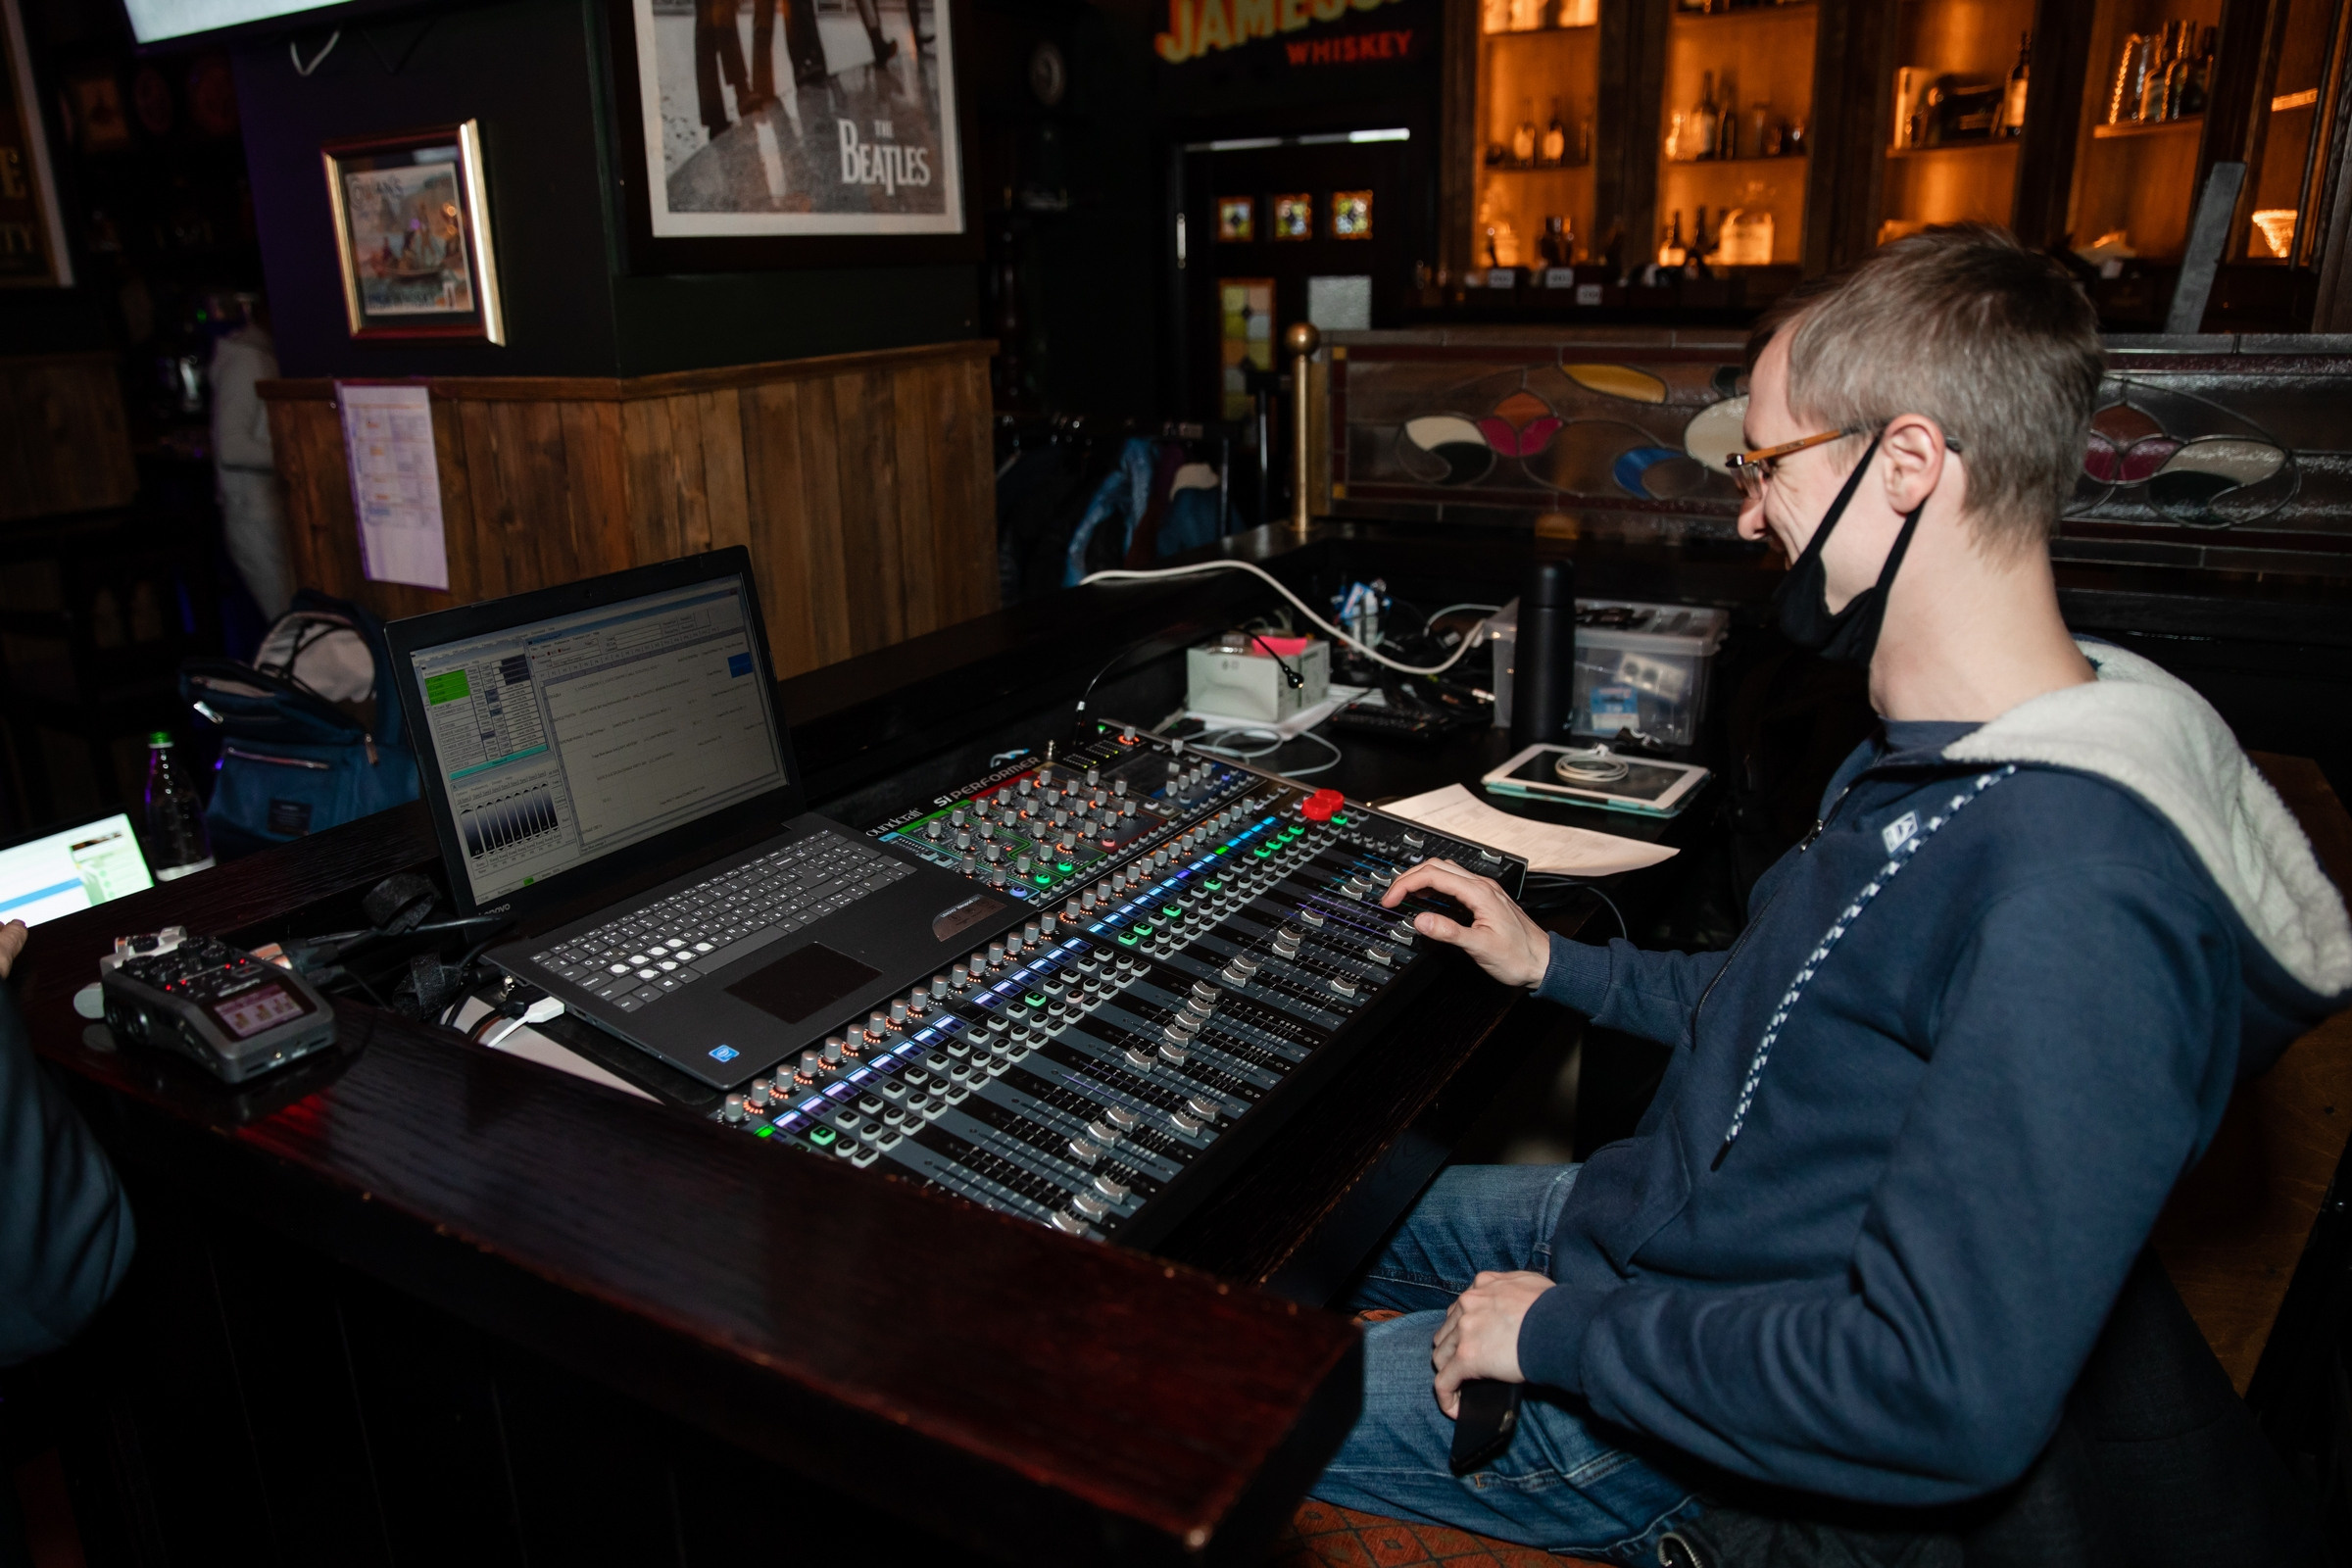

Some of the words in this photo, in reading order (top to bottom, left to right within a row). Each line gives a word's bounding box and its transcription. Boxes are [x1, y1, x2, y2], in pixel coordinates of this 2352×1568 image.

[1286, 29, 1413, 66] WHISKEY
[838, 119, 931, 196] BEATLES
[874, 120, 894, 138] THE
[865, 808, 924, 838] oundcraft
[933, 795, 953, 808] Si
[950, 757, 1041, 800] PERFORMER
